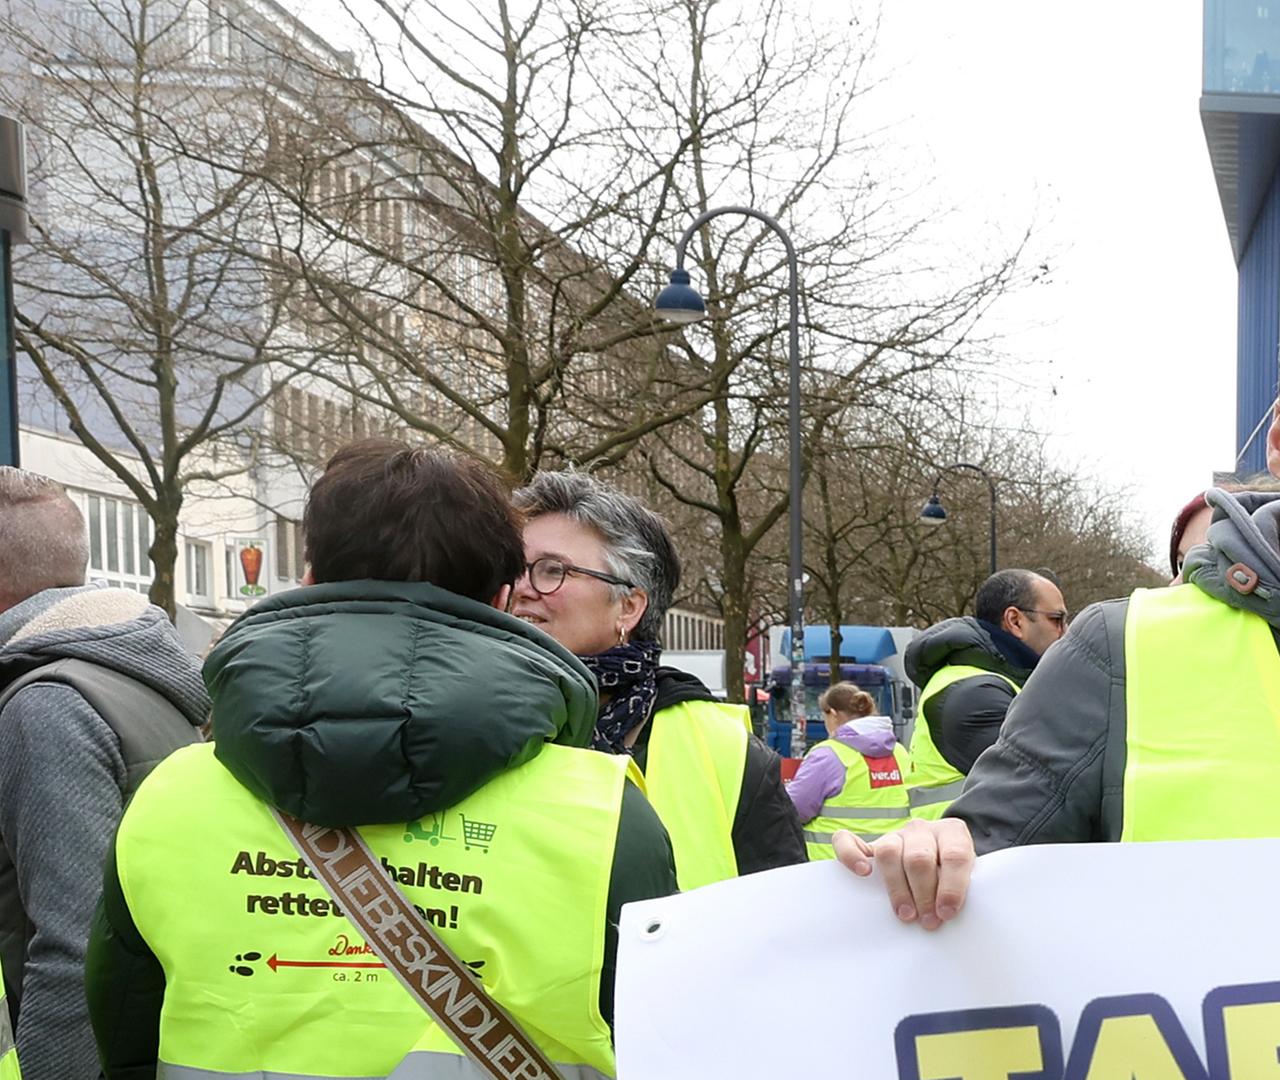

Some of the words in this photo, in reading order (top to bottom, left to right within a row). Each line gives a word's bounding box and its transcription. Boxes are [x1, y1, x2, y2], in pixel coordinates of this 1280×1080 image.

[230, 851, 318, 880] Abst
[333, 973, 350, 983] ca.
[354, 970, 362, 982] 2
[366, 974, 379, 983] m
